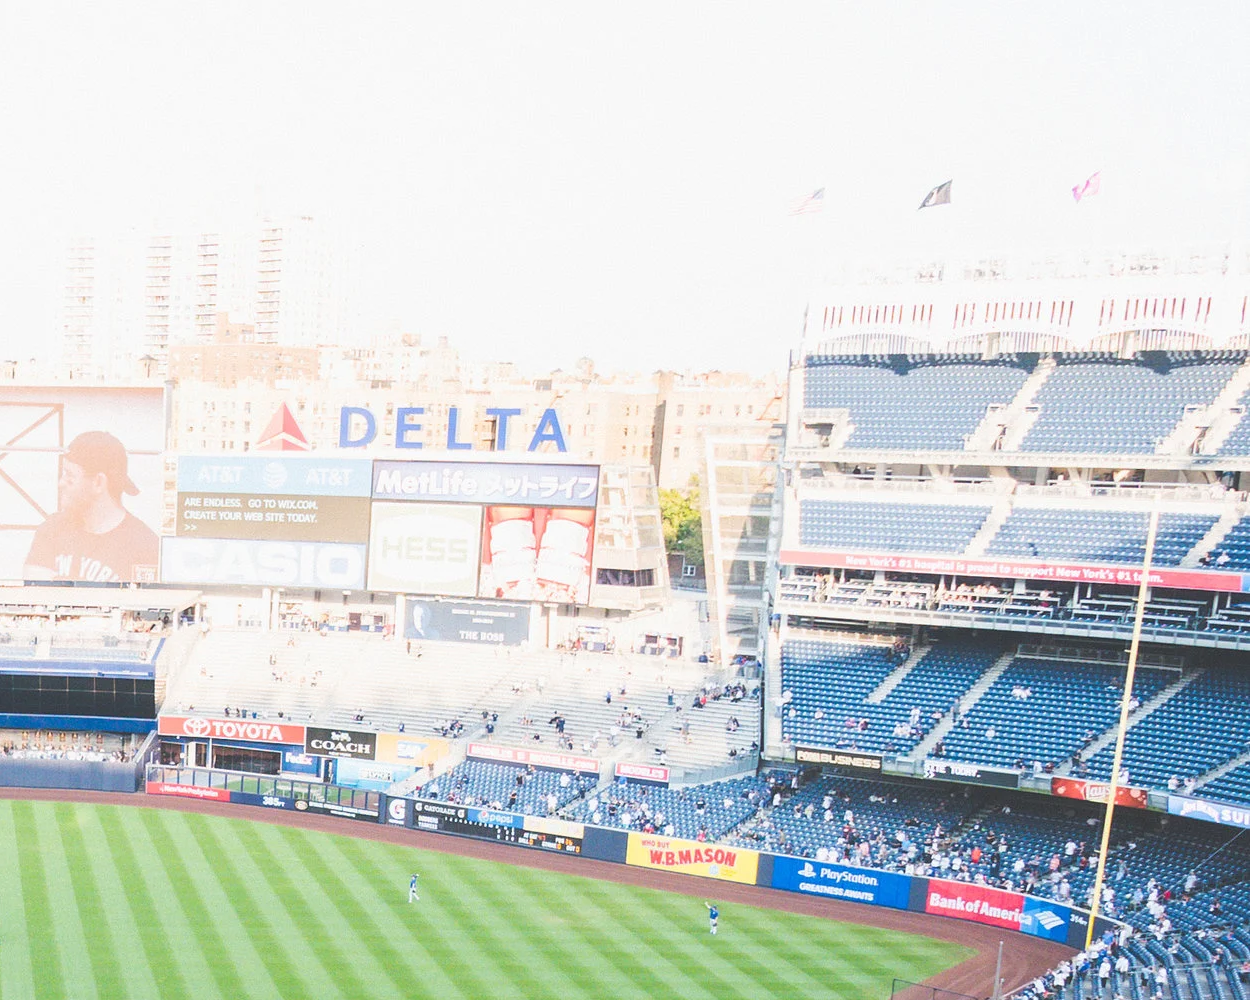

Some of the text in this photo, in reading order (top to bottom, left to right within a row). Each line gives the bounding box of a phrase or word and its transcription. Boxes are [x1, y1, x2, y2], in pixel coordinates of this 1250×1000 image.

[339, 406, 567, 452] DELTA
[198, 466, 353, 486] AT&T AT&T
[375, 468, 477, 495] MetLife
[485, 475, 597, 499] メットライフ
[184, 498, 202, 507] ARE
[203, 498, 242, 508] ENDLESS.
[247, 499, 262, 509] GO
[264, 500, 276, 509] TO
[183, 512, 318, 524] CREATE YOUR WEB SITE TODAY.
[381, 535, 468, 564] HESS
[173, 542, 363, 586] CASIO
[846, 555, 867, 567] New
[869, 557, 897, 568] York's
[914, 560, 955, 574] hospital
[956, 561, 965, 572] is
[966, 562, 997, 576] proud
[999, 564, 1011, 574] to
[1013, 565, 1054, 580] support
[1056, 567, 1081, 577] New
[1083, 569, 1114, 580] York's
[459, 630, 505, 642] THE BOSS
[212, 721, 283, 741] TOYOTA
[310, 740, 371, 754] COACH
[820, 753, 881, 769] BUSINESS
[490, 812, 513, 824] pepsi
[657, 841, 670, 849] BUT
[820, 867, 878, 886] PlayStation
[799, 881, 875, 901] GREATNESS AWAITS
[929, 892, 1032, 925] Bank of America
